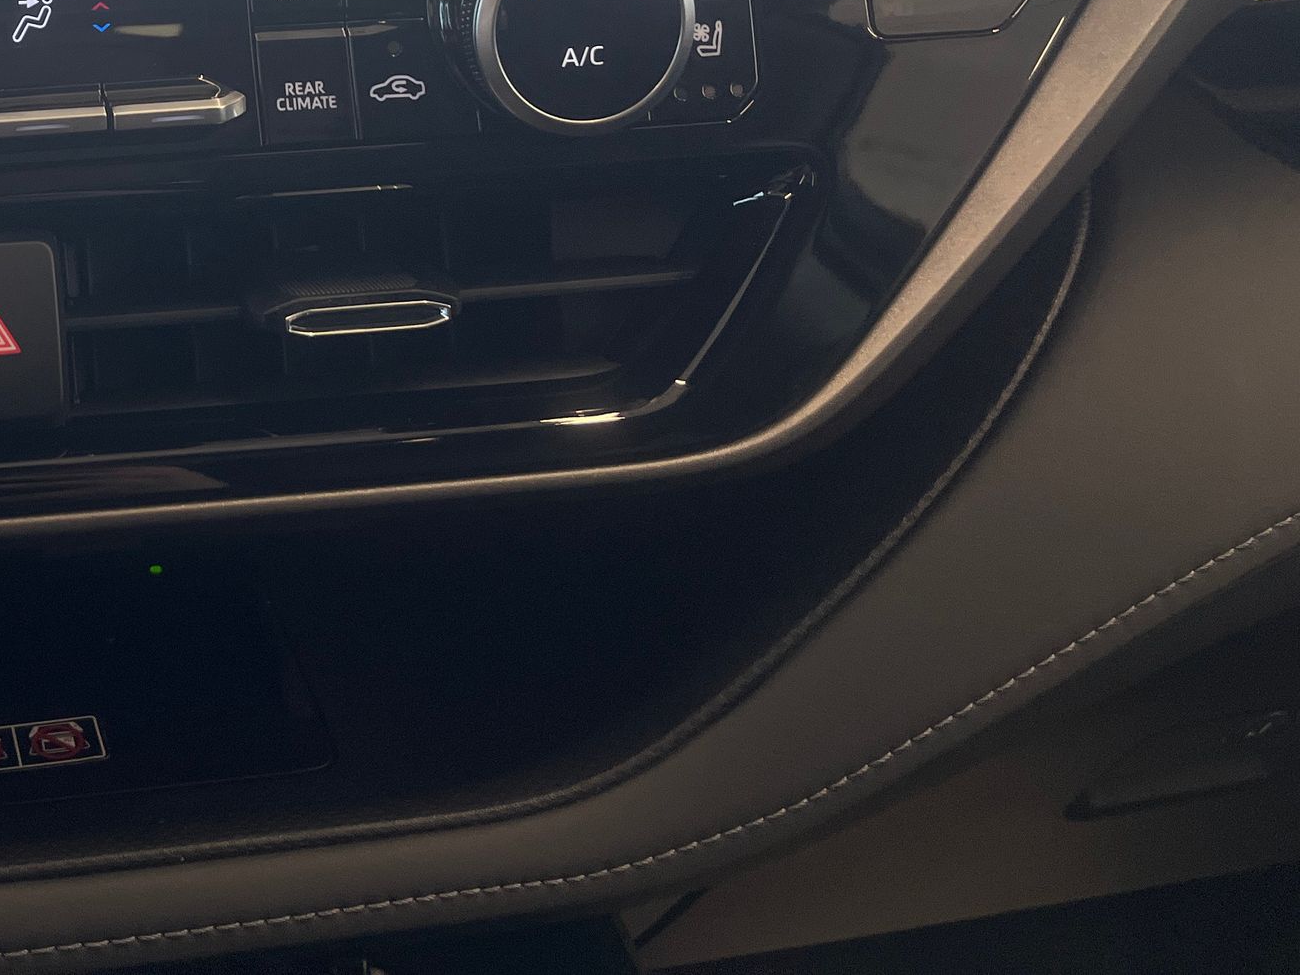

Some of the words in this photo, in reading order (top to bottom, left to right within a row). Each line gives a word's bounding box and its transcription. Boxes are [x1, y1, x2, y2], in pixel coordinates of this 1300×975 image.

[561, 45, 605, 68] A/C
[284, 81, 326, 96] REAR
[276, 94, 337, 111] CLIMATE
